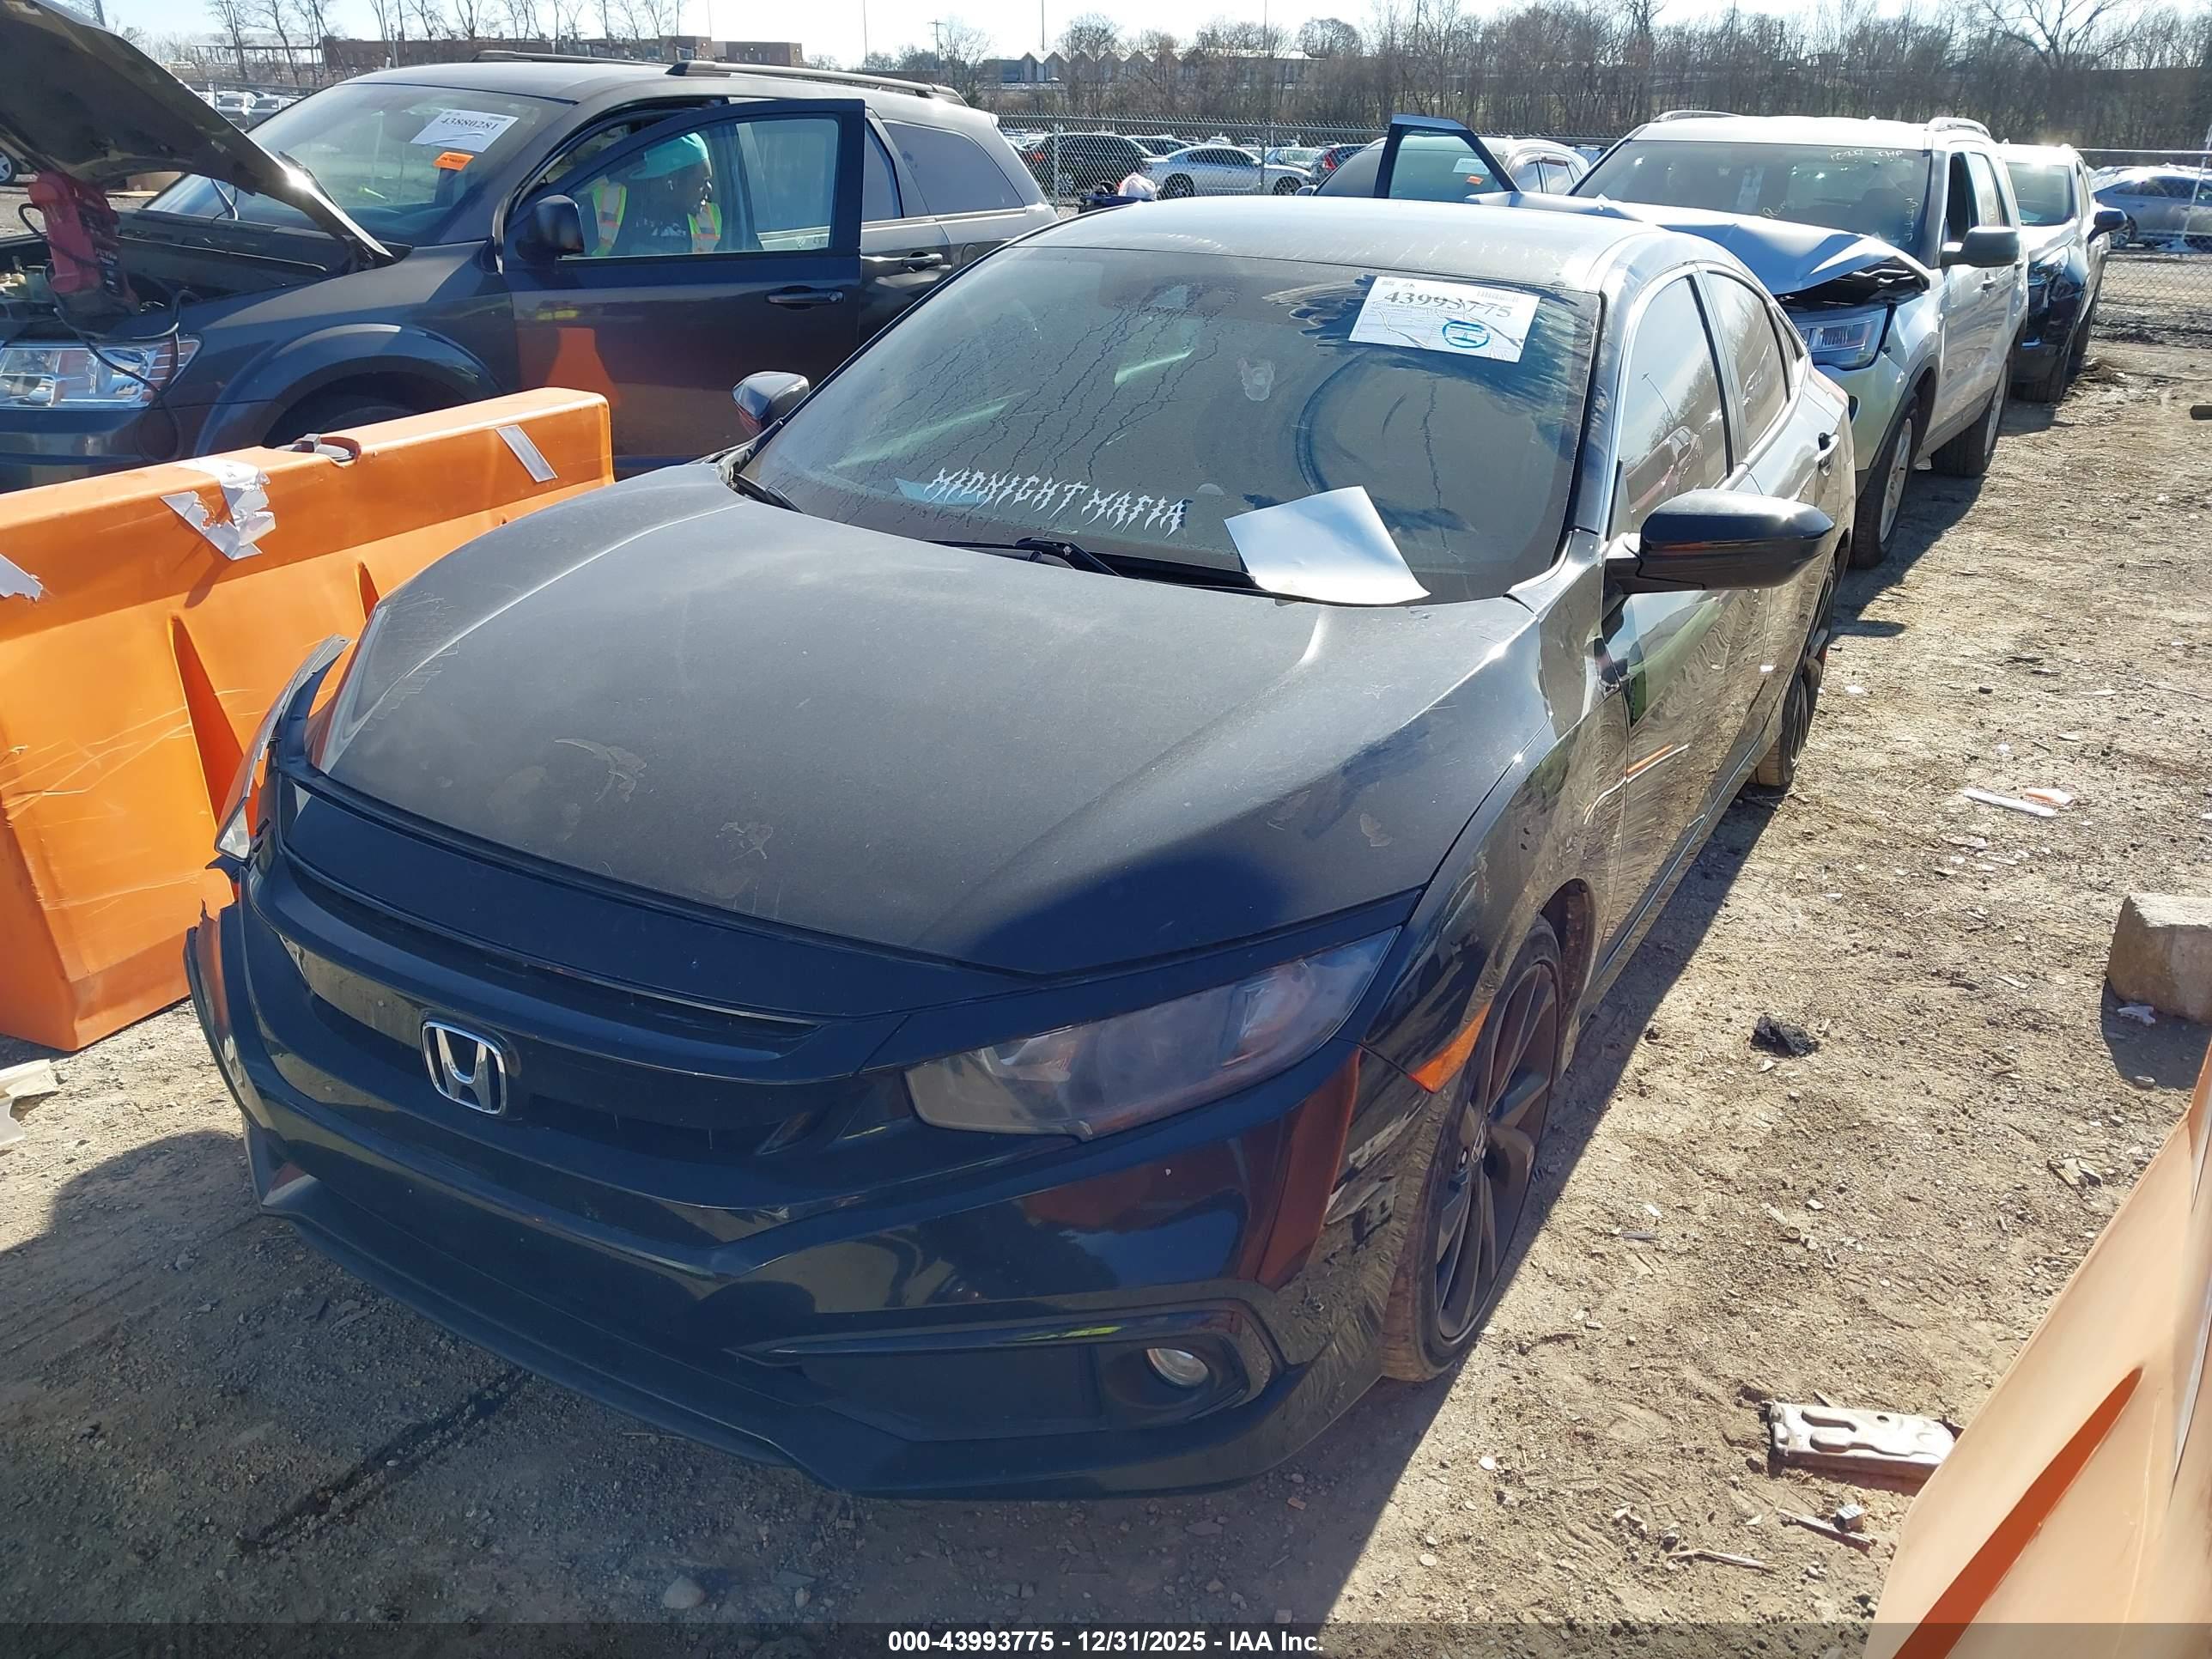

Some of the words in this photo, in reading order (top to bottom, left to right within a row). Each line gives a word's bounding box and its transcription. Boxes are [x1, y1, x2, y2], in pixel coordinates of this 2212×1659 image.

[441, 117, 499, 131] 43880281
[1384, 291, 1514, 317] 43993775
[923, 466, 1090, 520] MIDNIGHT
[1080, 488, 1188, 539] MAFIA
